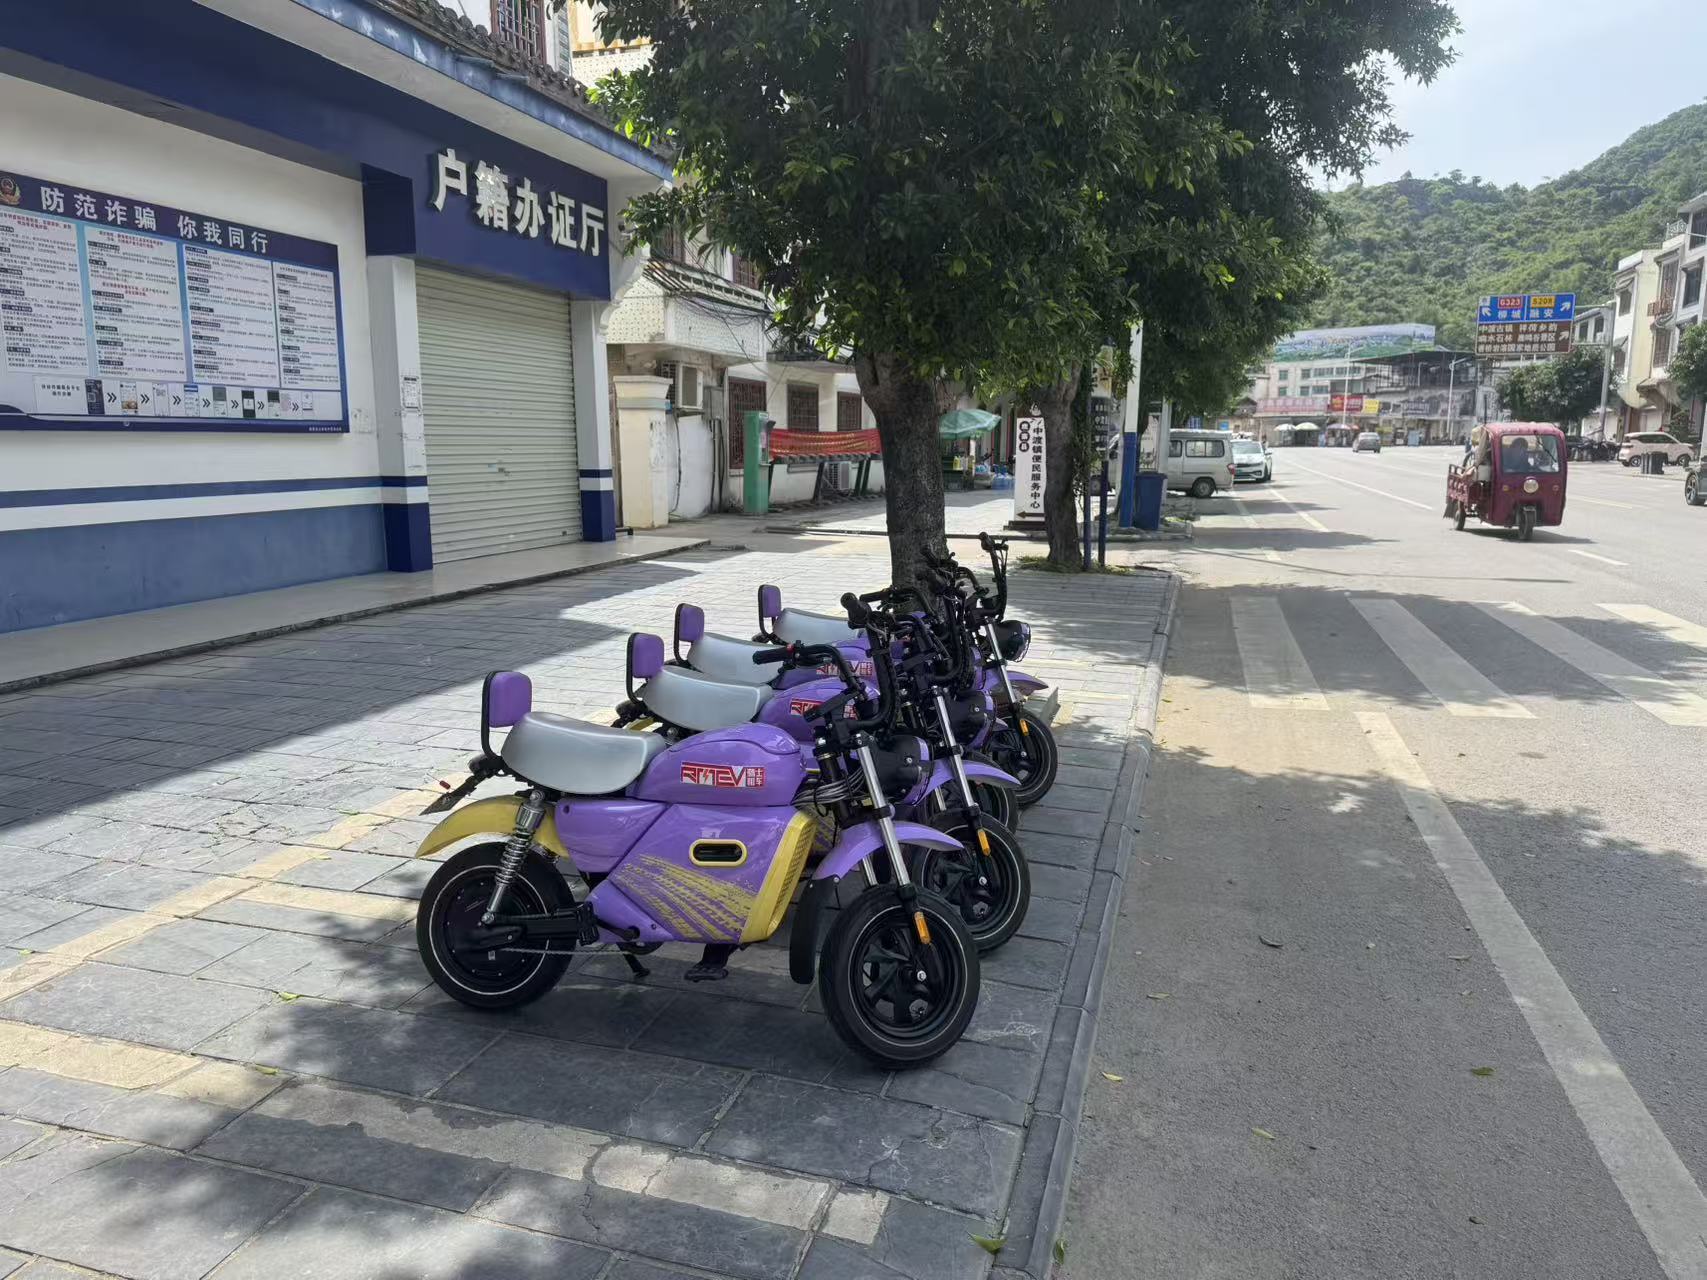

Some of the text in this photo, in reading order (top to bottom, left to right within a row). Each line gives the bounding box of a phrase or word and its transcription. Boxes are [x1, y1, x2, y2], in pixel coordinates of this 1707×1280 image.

[40, 186, 271, 254] 防范诈骗 你我同行
[434, 148, 605, 257] 户籍办证厅
[1500, 298, 1521, 306] G323
[1030, 427, 1043, 509] 中渡镇便民服务中心
